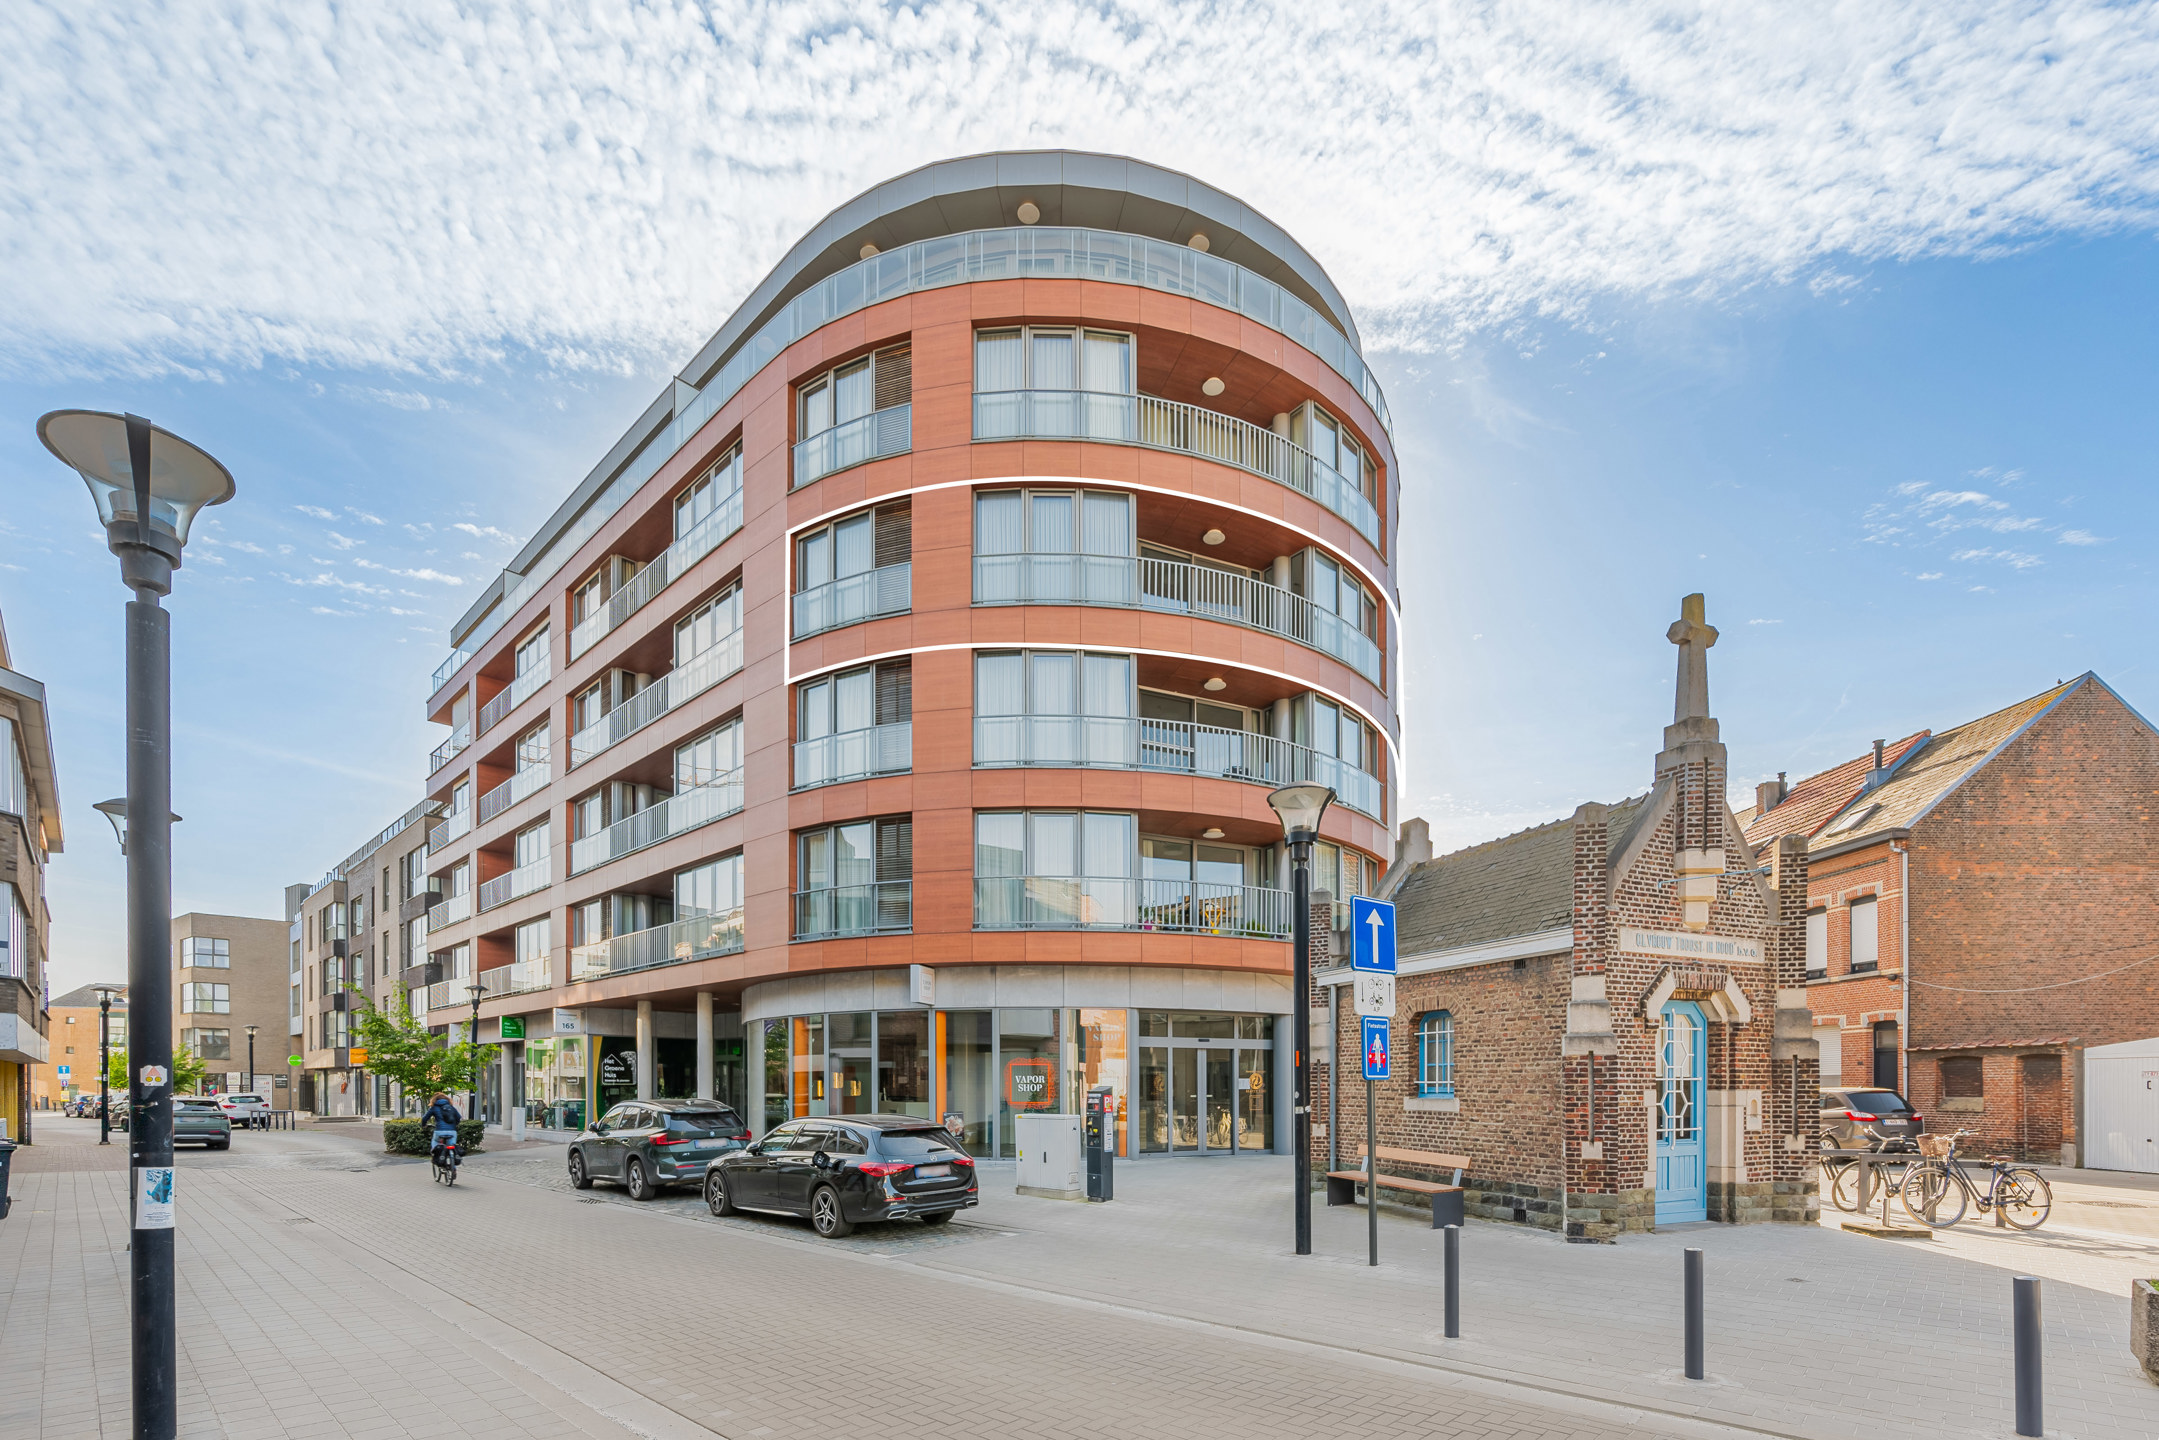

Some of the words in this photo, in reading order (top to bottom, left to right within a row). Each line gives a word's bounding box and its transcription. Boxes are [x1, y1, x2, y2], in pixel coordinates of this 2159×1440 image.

[561, 1022, 575, 1030] 165
[1015, 1075, 1045, 1084] VAPOR
[1017, 1083, 1043, 1092] SHOP
